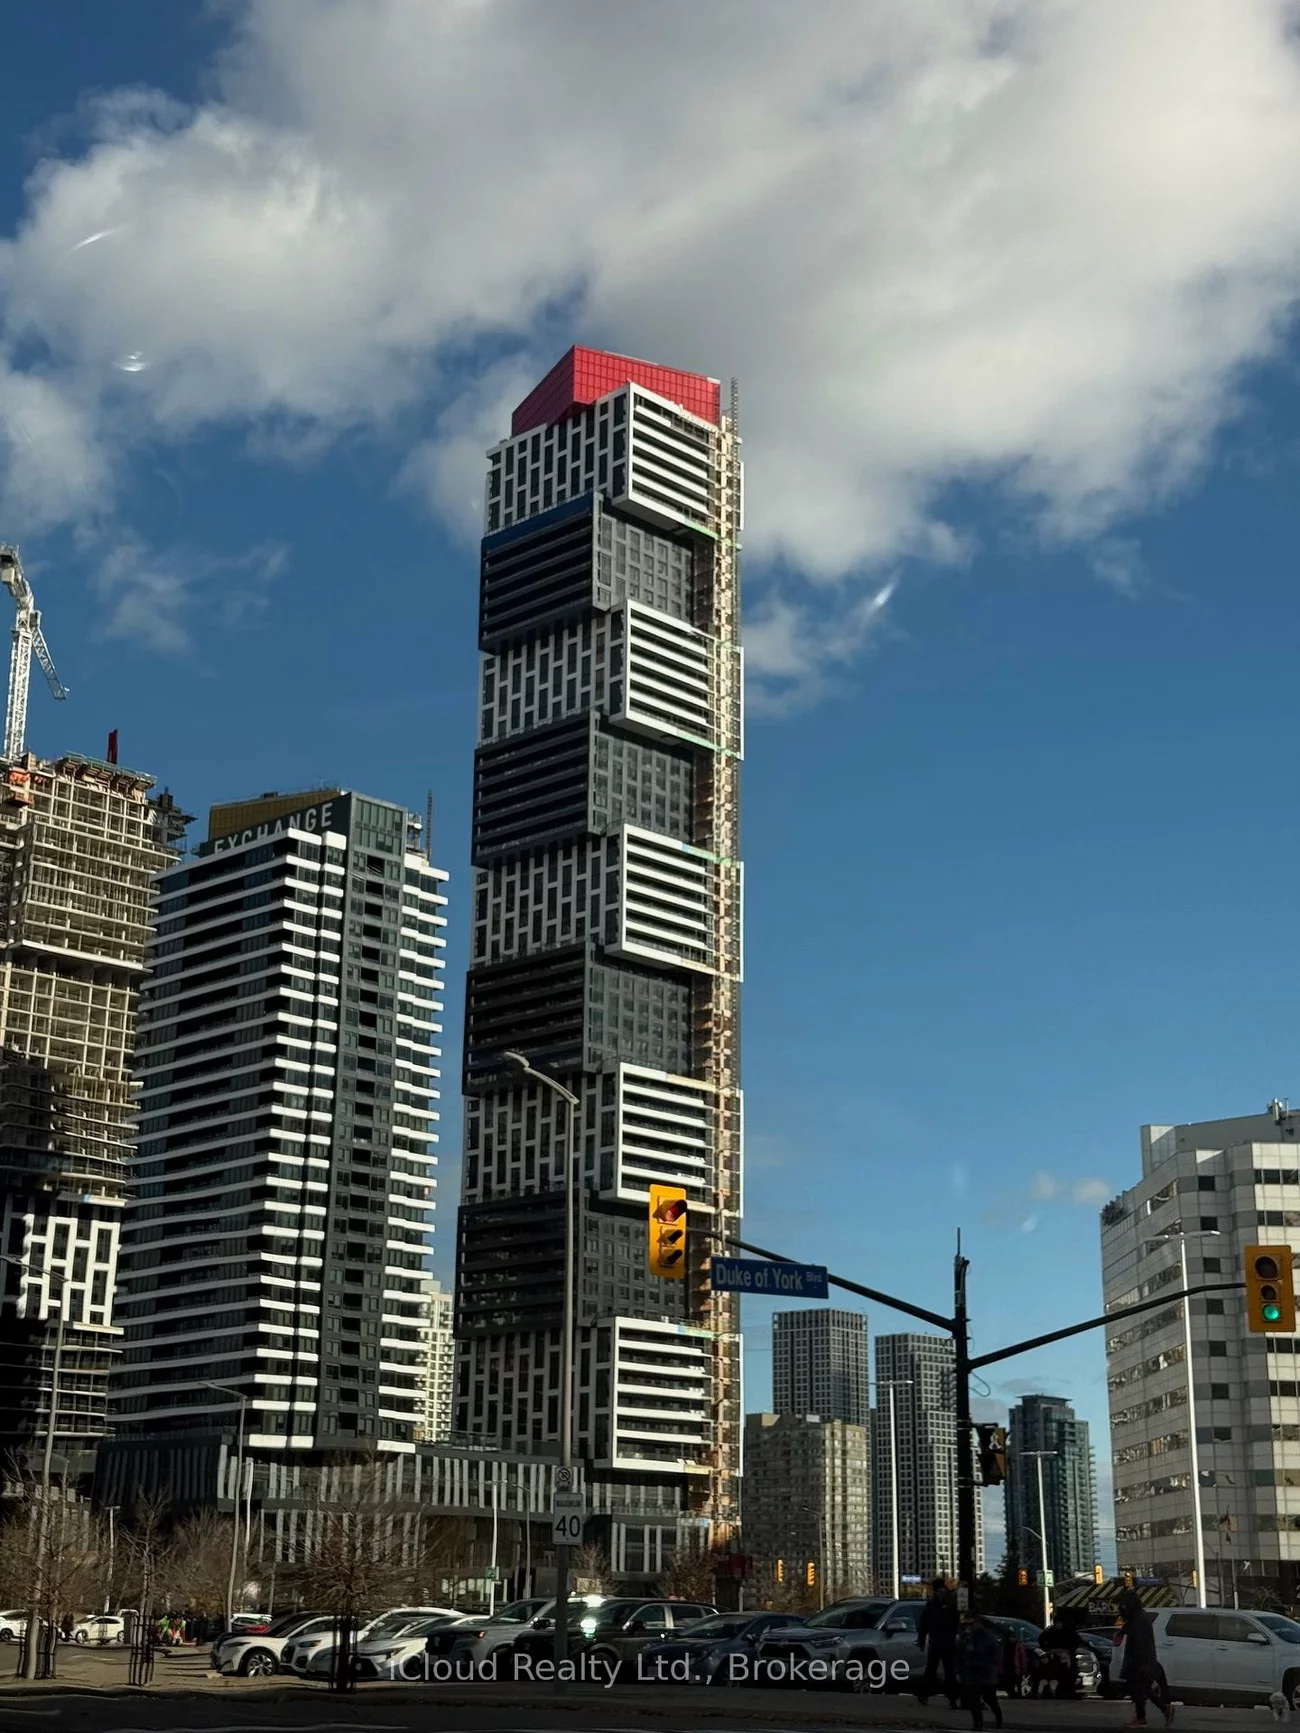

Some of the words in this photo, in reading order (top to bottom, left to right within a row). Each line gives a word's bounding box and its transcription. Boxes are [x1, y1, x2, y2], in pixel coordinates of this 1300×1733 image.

[715, 1263, 752, 1287] Duke
[754, 1267, 769, 1288] of
[772, 1267, 804, 1291] York
[555, 1515, 581, 1537] 40
